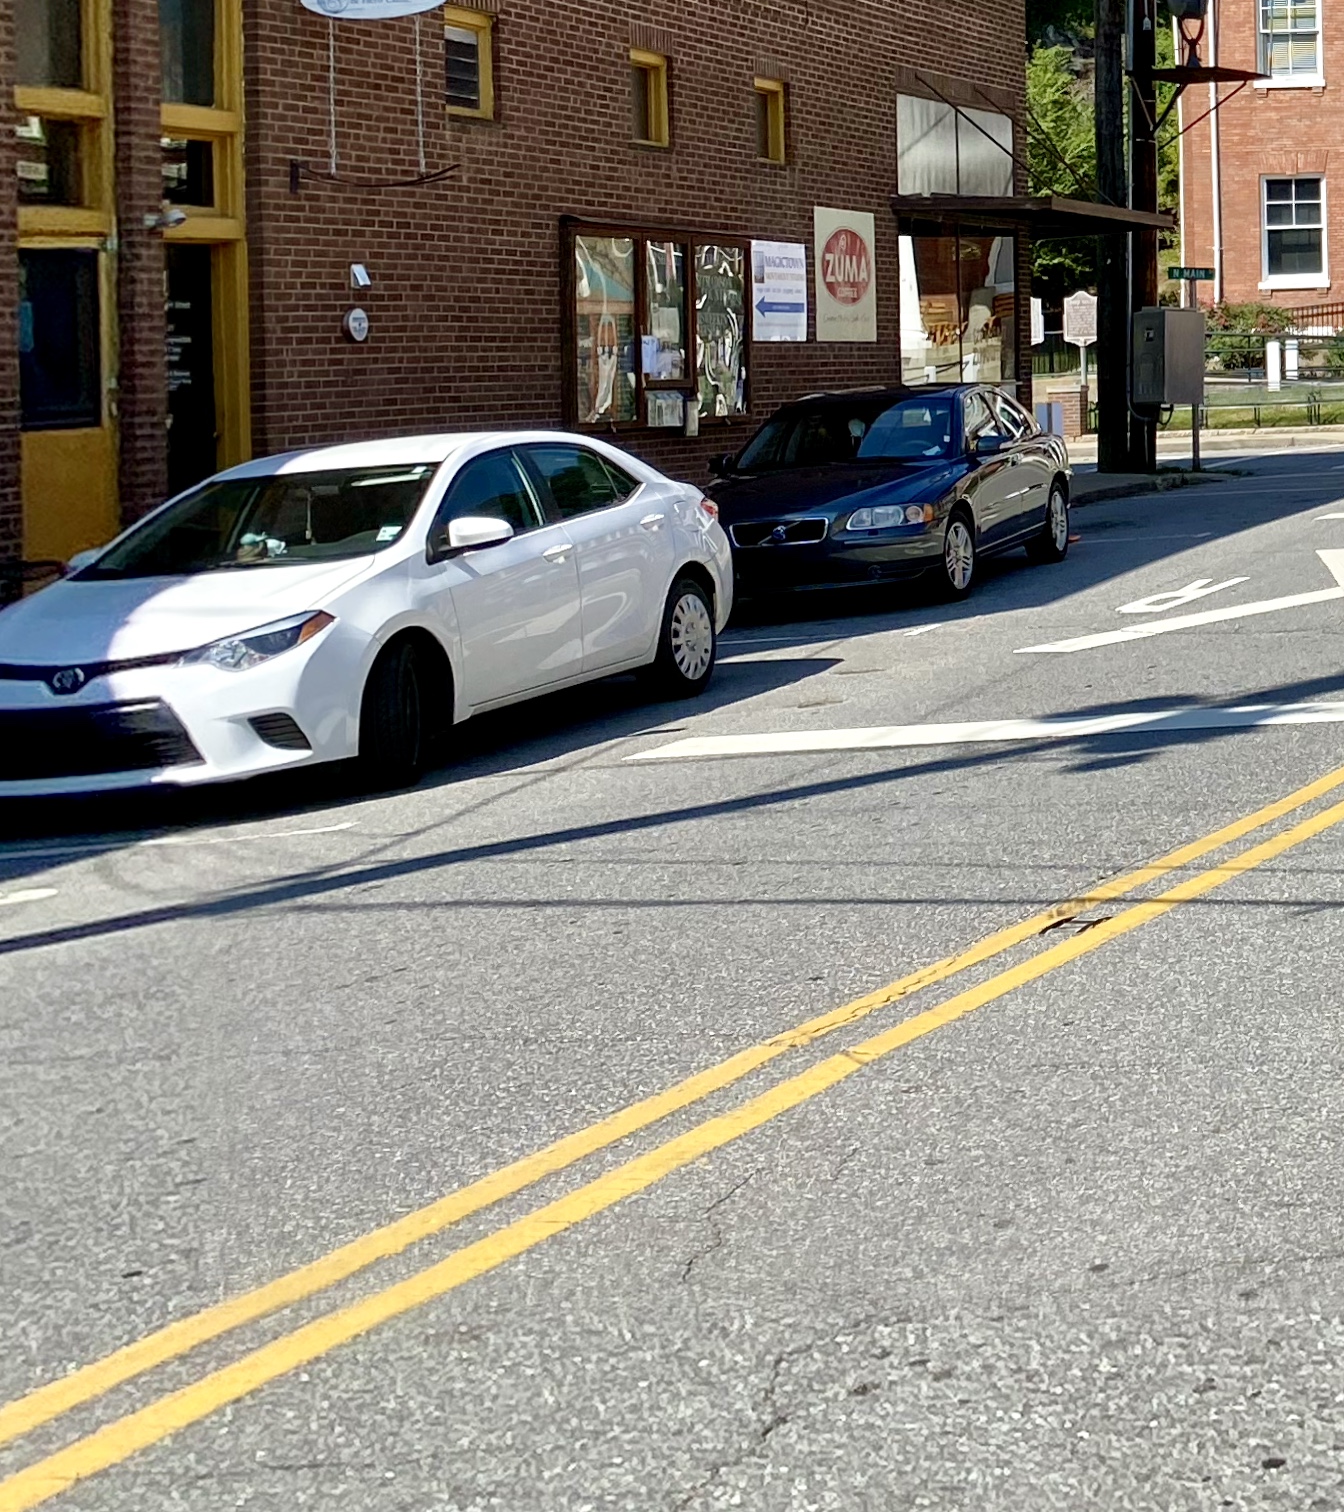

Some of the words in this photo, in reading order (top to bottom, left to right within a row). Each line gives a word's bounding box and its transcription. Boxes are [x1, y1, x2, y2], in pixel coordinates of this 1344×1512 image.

[825, 253, 868, 282] ZUMA
[1172, 268, 1180, 278] N
[1183, 268, 1206, 278] MAIN
